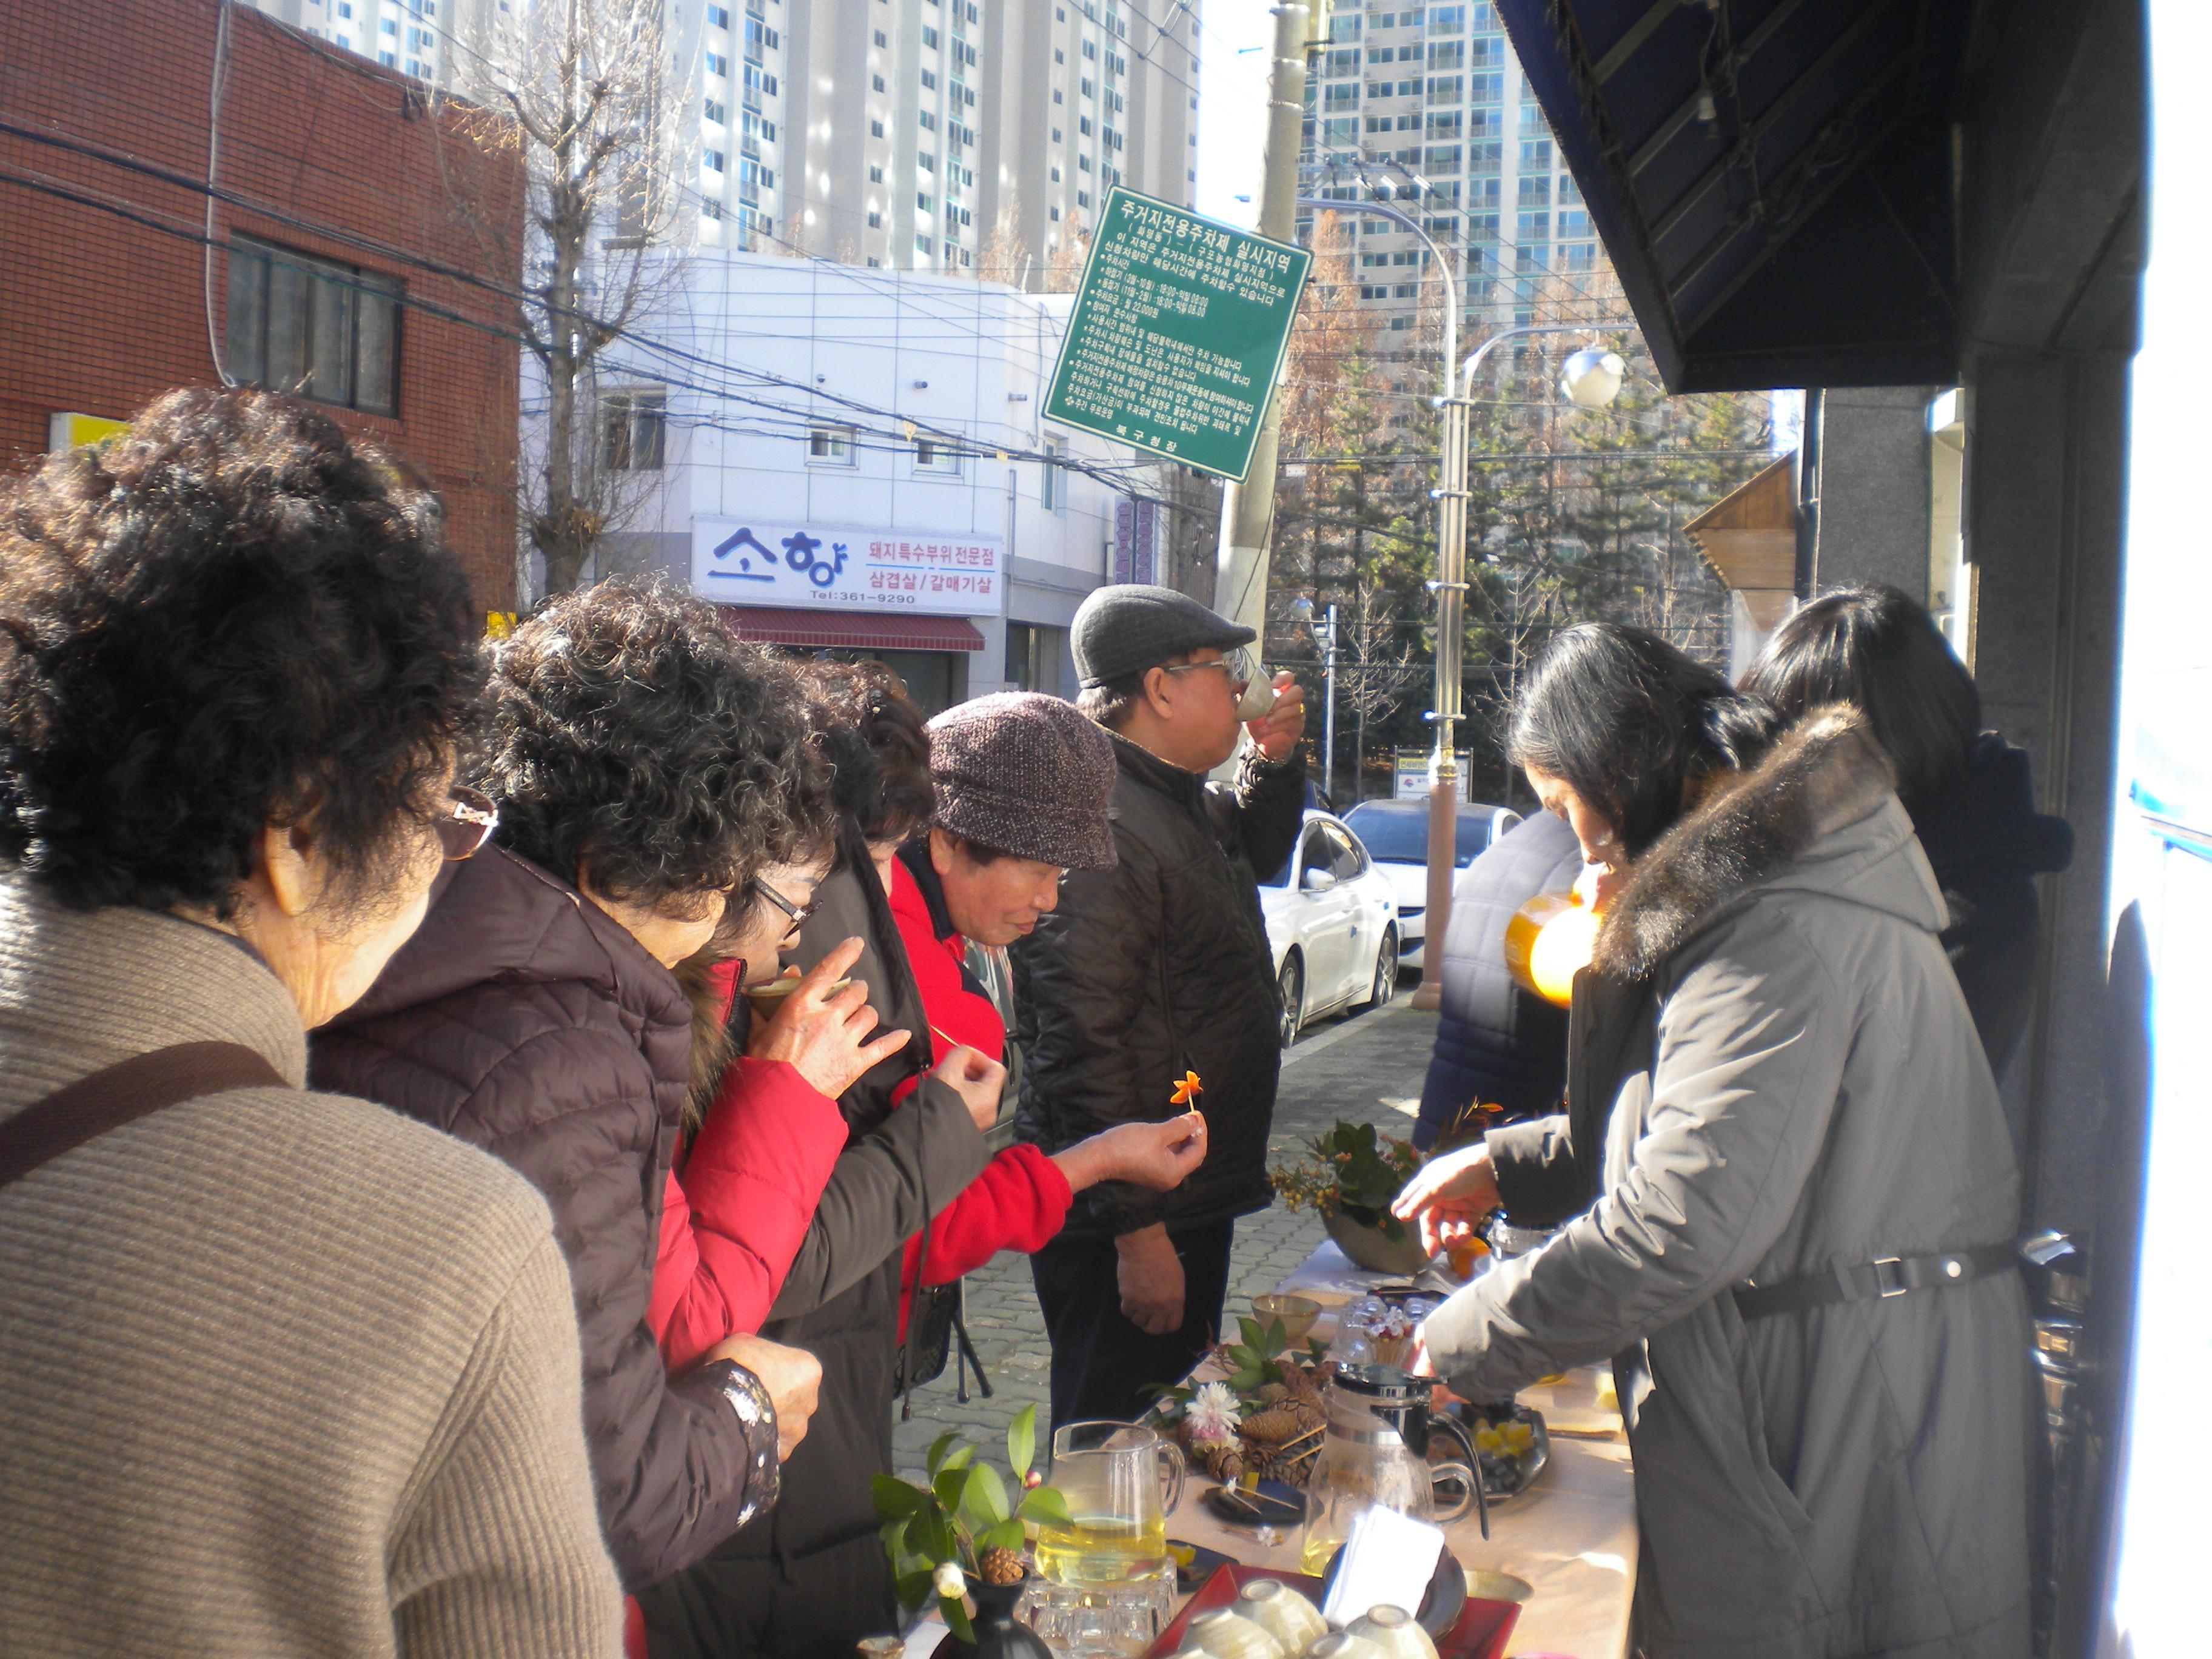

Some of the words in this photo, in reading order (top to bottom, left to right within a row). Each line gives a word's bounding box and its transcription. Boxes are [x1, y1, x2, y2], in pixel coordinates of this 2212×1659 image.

[1105, 253, 1130, 270] 주차시간
[1116, 232, 1127, 244] 이
[1130, 236, 1157, 255] 지역은
[1161, 246, 1230, 279] 주거지전용주차제
[1233, 272, 1285, 298] 실시지역으로
[1121, 199, 1231, 253] 주거지전용주차제
[1236, 240, 1292, 274] 실시지역
[1104, 240, 1150, 264] 신청차량만
[1152, 256, 1197, 281] 해당시간에
[1238, 286, 1275, 307] 있습니다
[1091, 313, 1118, 330] 사용시간
[707, 527, 848, 589] 소향
